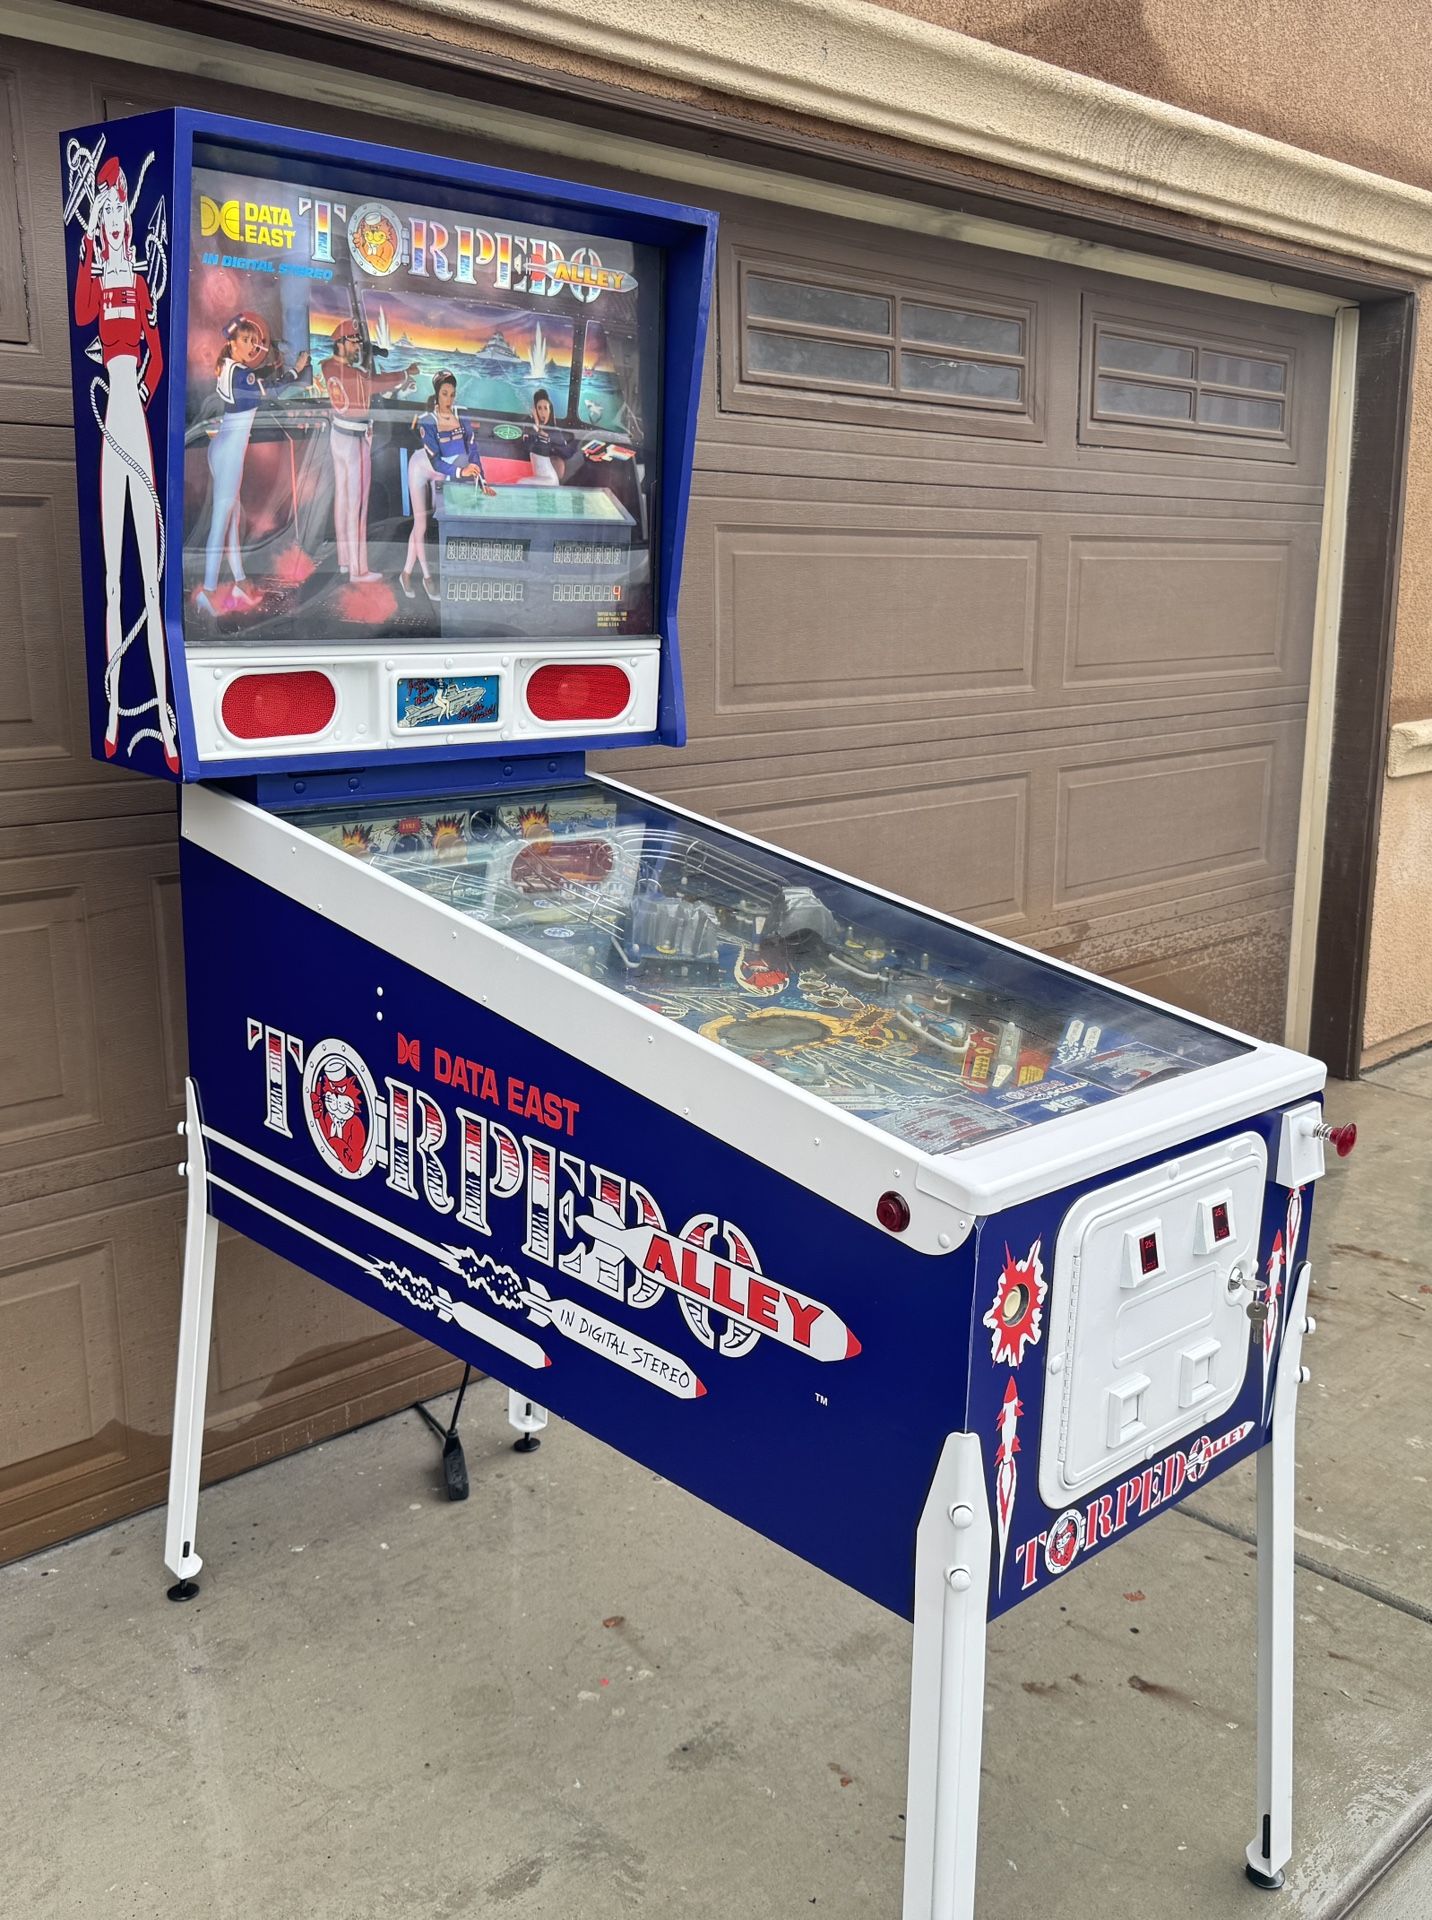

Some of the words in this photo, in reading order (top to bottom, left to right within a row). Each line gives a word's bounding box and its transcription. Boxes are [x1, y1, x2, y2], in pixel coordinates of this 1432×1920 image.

[245, 202, 293, 227] DATA
[245, 224, 296, 249] EAST
[202, 252, 219, 265] IN
[222, 256, 275, 273] DIGITAL
[279, 263, 333, 281] STEREO
[298, 197, 602, 304] TORPEDO
[554, 263, 625, 289] ALLEY
[434, 1047, 500, 1106] DATA
[508, 1076, 580, 1137] EAST
[246, 1016, 763, 1359] TORPEDO
[643, 1233, 824, 1349] ALLEY
[560, 1308, 575, 1327] IN
[579, 1318, 629, 1357] DIGITAL
[631, 1346, 691, 1389] STEREO
[815, 1392, 830, 1407] TM
[1202, 1424, 1247, 1461] ALLEY
[1016, 1435, 1211, 1591] TORPEDO
